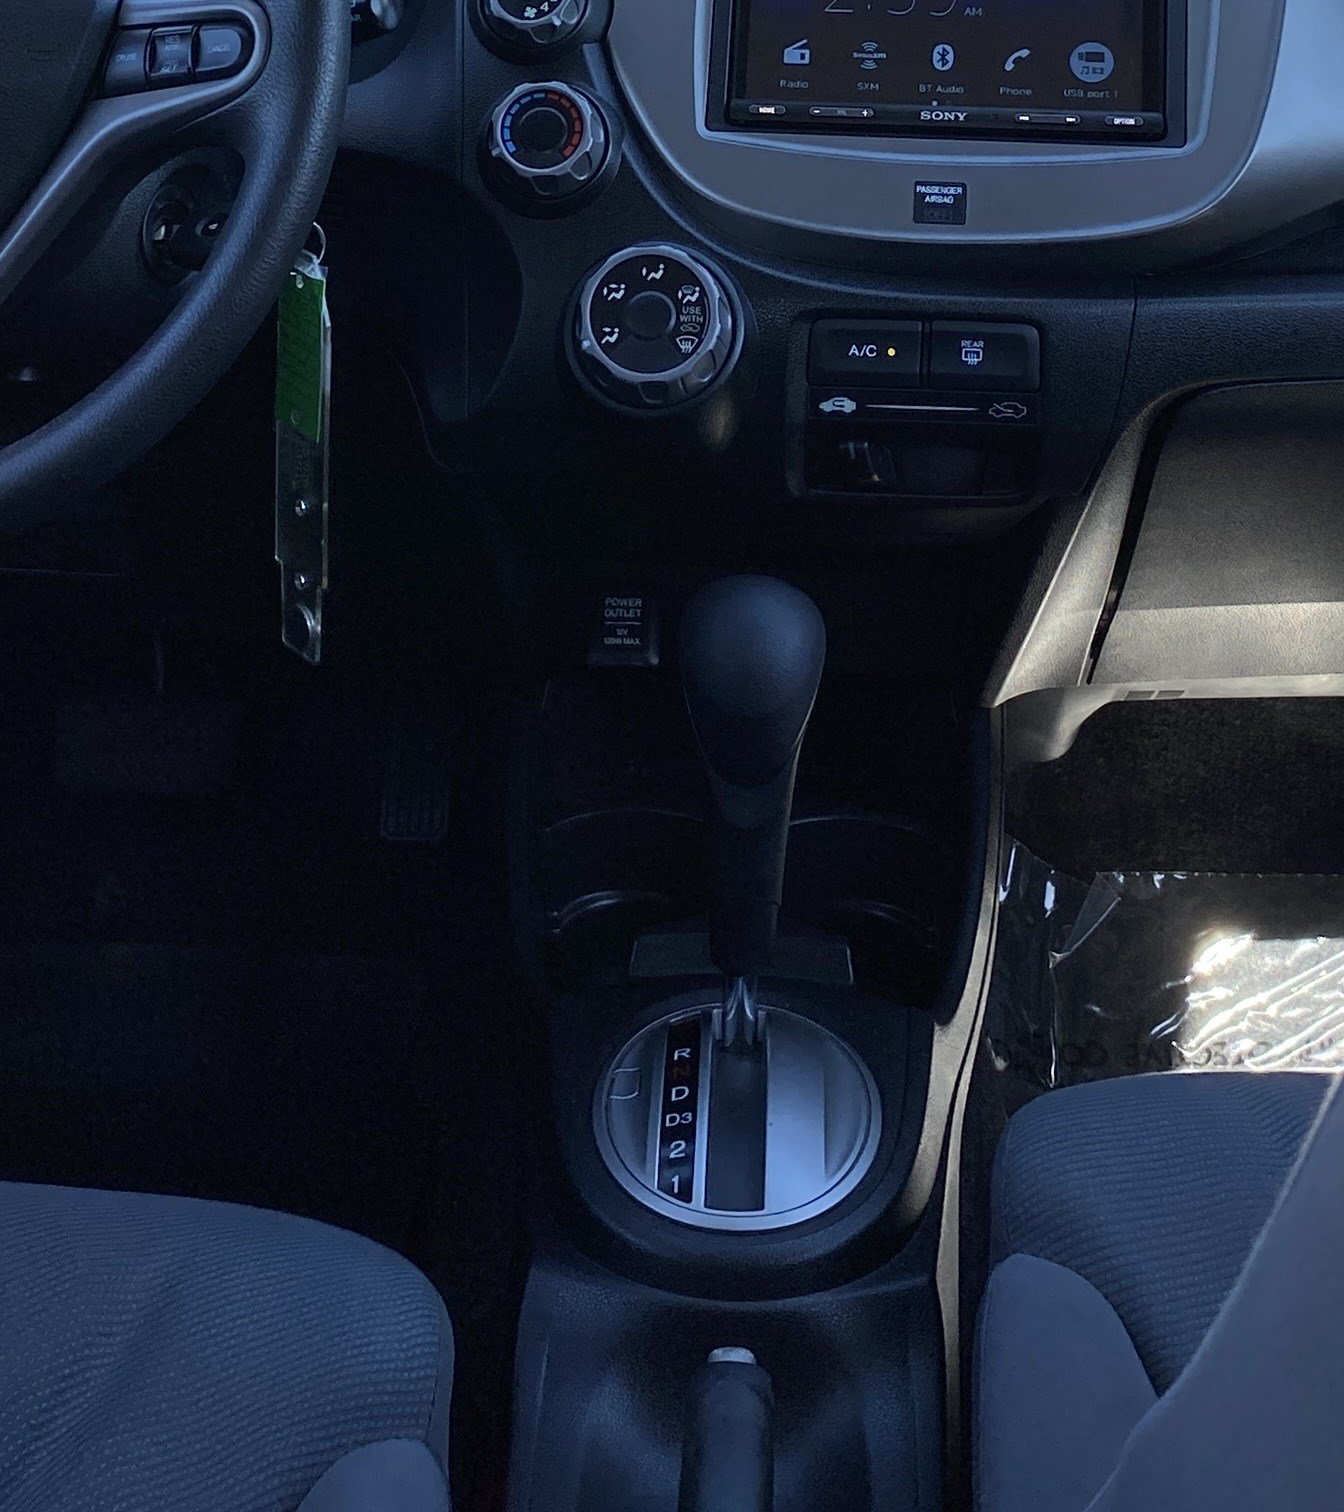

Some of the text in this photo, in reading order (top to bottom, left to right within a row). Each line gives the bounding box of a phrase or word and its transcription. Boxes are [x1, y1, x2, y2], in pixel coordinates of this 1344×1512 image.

[540, 2, 549, 12] 4
[964, 7, 983, 16] AM
[780, 78, 809, 89] Radio
[857, 82, 880, 91] SXM
[919, 83, 964, 94] BT Audio
[1000, 86, 1033, 97] Phone
[1064, 88, 1084, 98] USB
[1087, 90, 1111, 100] port
[920, 110, 968, 122] SONY
[916, 185, 963, 194] PASSENGER
[924, 195, 954, 204] AIRBAG
[682, 306, 702, 315] USE
[679, 315, 703, 323] WITH
[961, 340, 984, 348] REAR
[848, 345, 877, 357] A/C
[605, 597, 642, 607] POWER
[604, 608, 641, 618] OUTLET
[673, 1048, 692, 1061] R
[671, 1086, 689, 1101] D
[665, 1112, 693, 1127] D3
[669, 1140, 687, 1159] 2
[672, 1174, 680, 1194] 1
